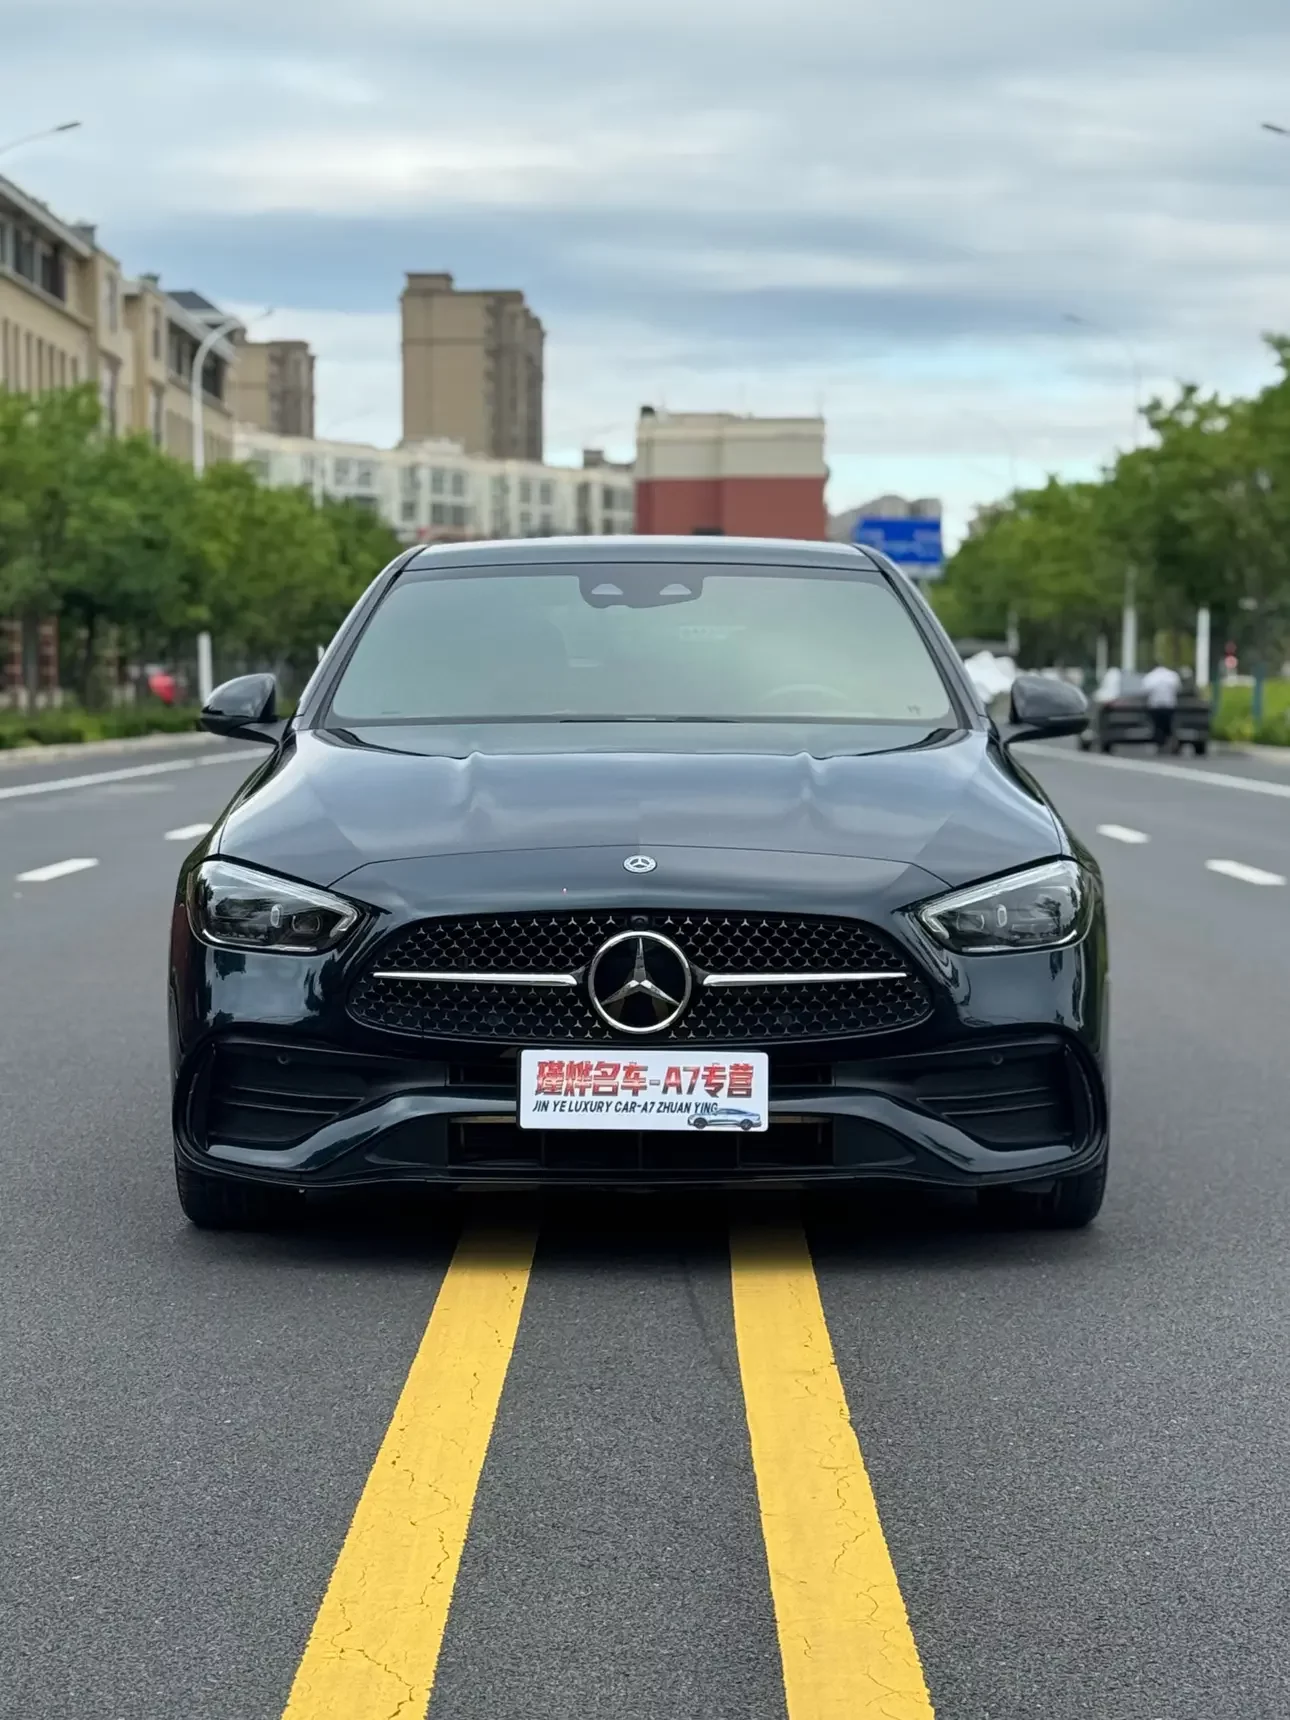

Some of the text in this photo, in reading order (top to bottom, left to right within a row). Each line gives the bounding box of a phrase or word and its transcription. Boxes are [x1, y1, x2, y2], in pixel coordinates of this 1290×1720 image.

[532, 1100, 550, 1112] JIN
[614, 1101, 655, 1113] CAR-A7
[656, 1101, 692, 1114] ZHUAN
[694, 1102, 719, 1115] YING
